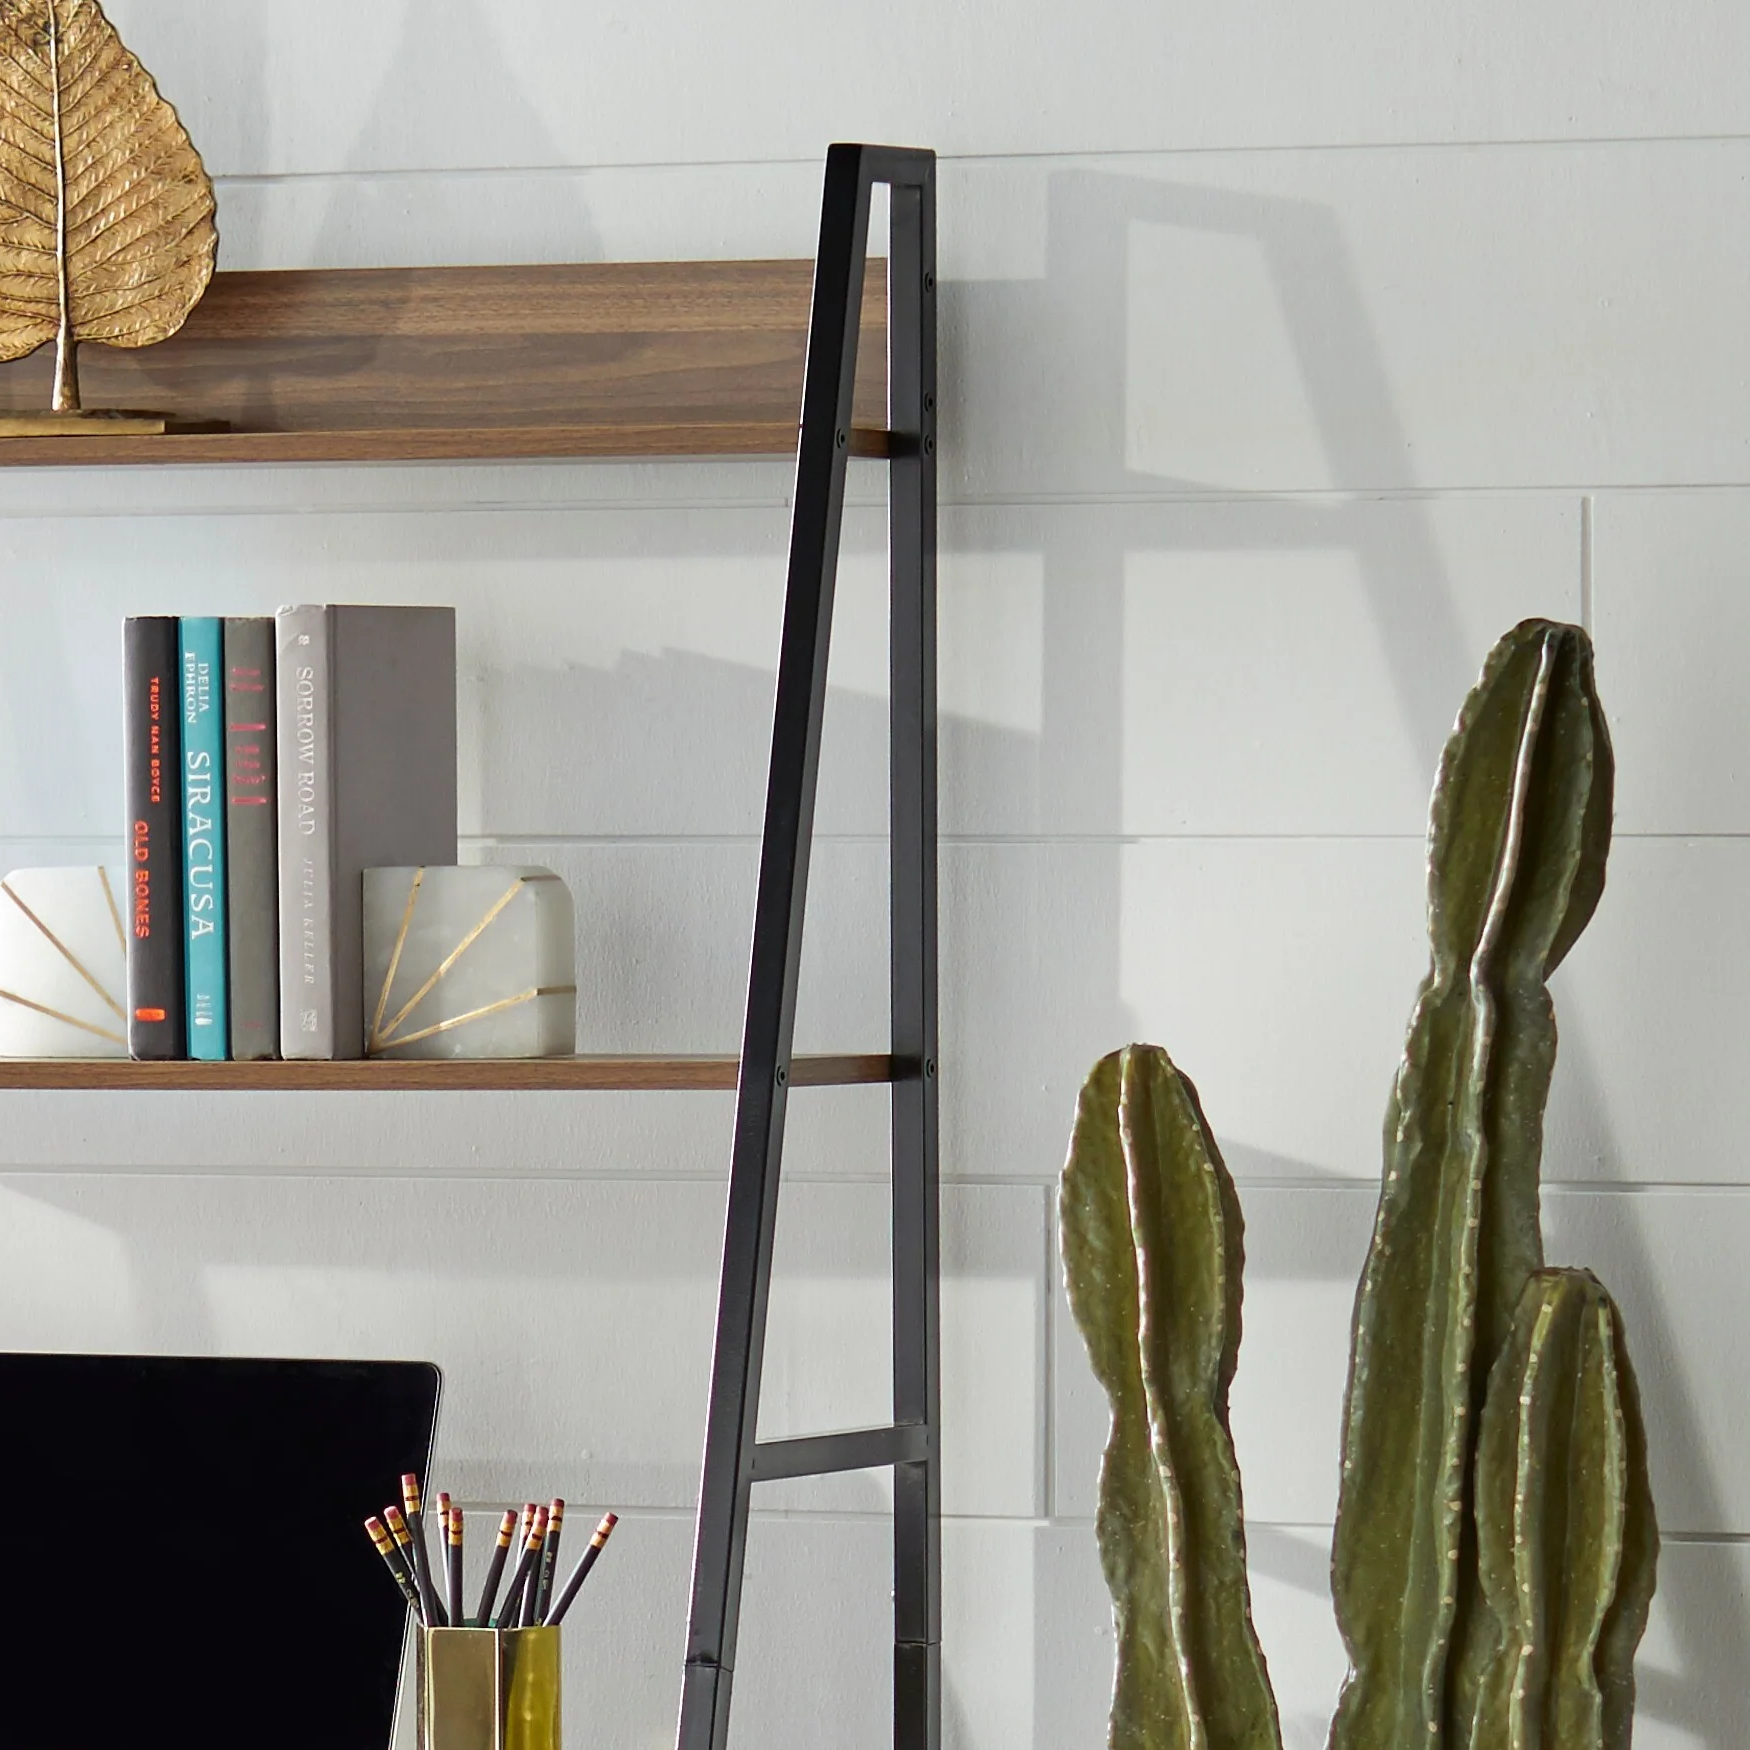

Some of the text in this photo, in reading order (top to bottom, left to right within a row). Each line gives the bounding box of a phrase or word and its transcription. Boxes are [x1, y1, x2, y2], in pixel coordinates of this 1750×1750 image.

[150, 677, 159, 722] TRUDY
[184, 652, 197, 724] EPHRON
[198, 662, 210, 713] DELIA
[151, 725, 160, 756] NAN
[296, 666, 315, 835] SORROW ROAD
[134, 820, 150, 938] OLD BONES
[186, 751, 215, 939] SIRACUSA
[303, 857, 314, 985] JULIA KELLER
